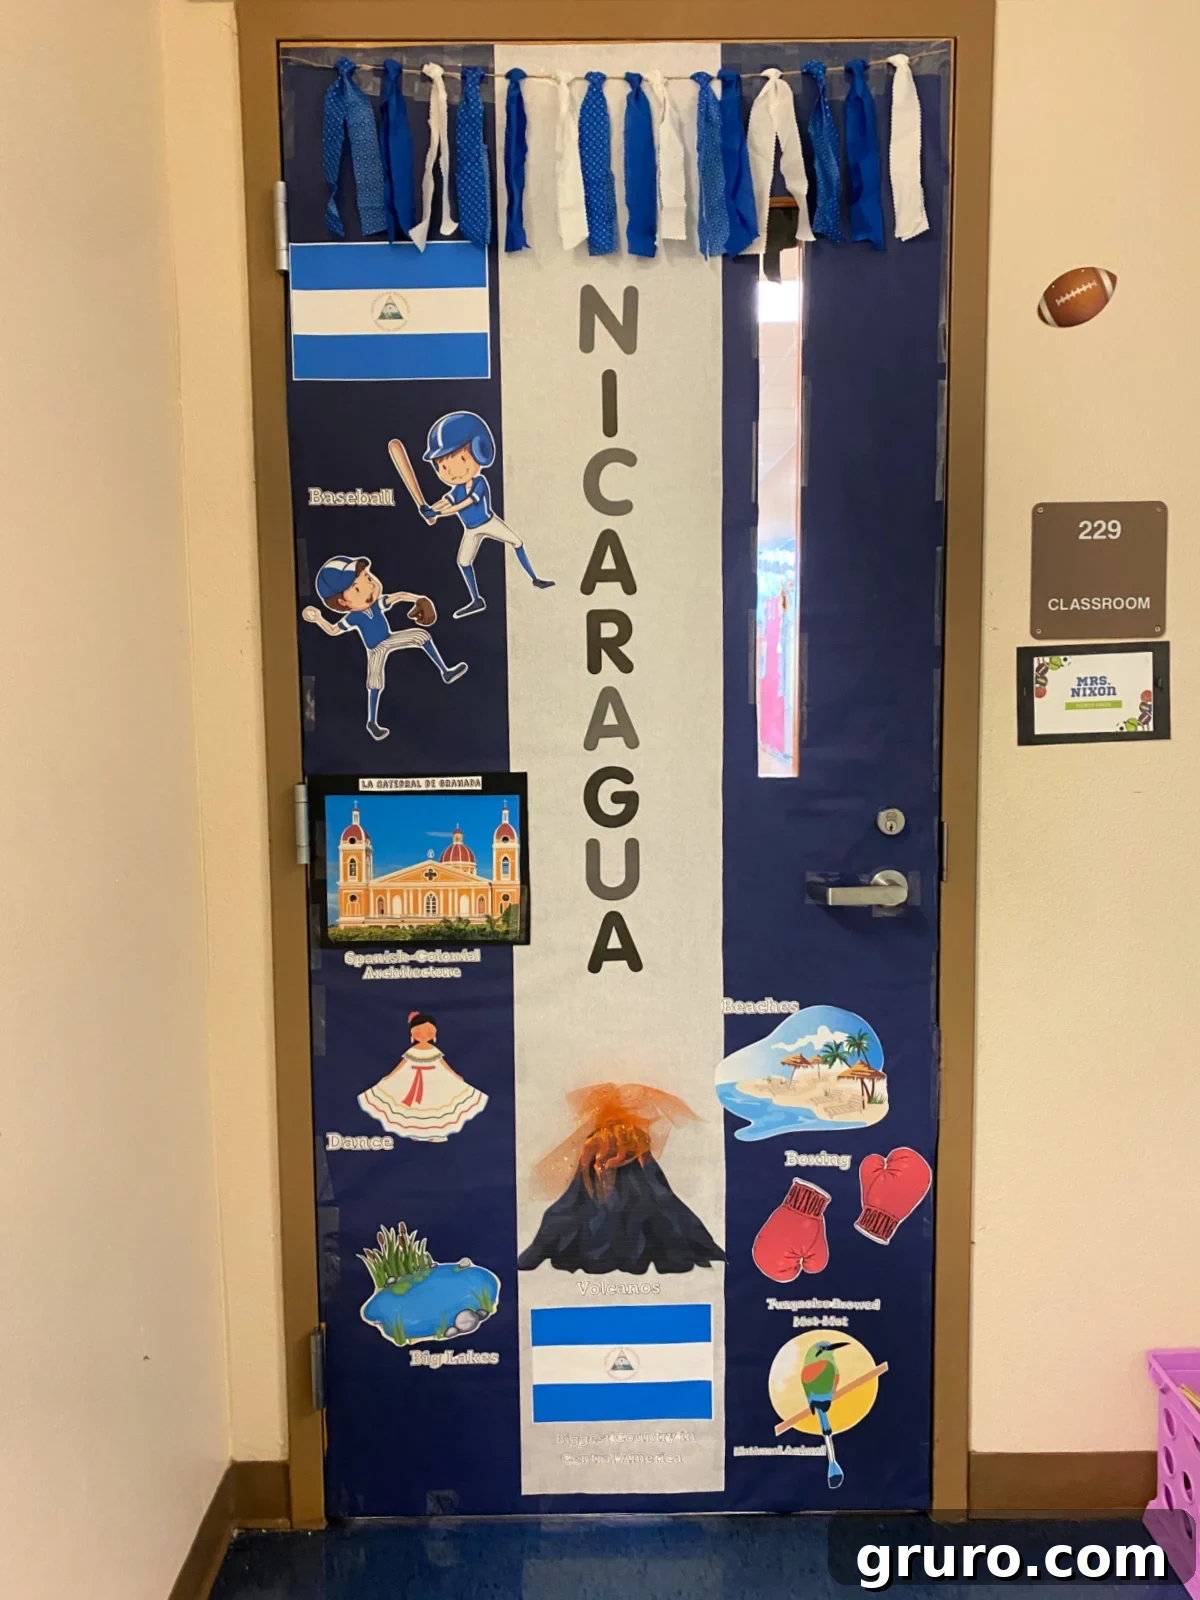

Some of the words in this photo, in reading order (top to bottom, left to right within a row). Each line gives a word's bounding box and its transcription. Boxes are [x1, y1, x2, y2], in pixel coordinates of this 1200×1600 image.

[308, 487, 395, 506] Baseball
[1078, 520, 1121, 540] 229
[1048, 597, 1151, 611] CLASSROOM
[579, 284, 643, 974] NICARAGUA
[1076, 676, 1111, 686] MRS.
[361, 780, 374, 789] LA
[376, 779, 422, 789] CATEDRAL
[425, 779, 436, 788] DE
[439, 779, 481, 788] GRANADA
[344, 948, 481, 968] Spanish-Colonial
[362, 965, 462, 979] Architecture
[721, 998, 799, 1014] Beaches
[326, 1132, 394, 1150] Dance
[784, 1150, 852, 1170] Boxing
[577, 1281, 661, 1296] Volcanos
[410, 1350, 443, 1369] Big
[445, 1350, 499, 1366] Lakes
[556, 1433, 611, 1447] Biggest
[614, 1431, 676, 1444] Country
[561, 1452, 616, 1464] Central
[619, 1452, 683, 1464] America
